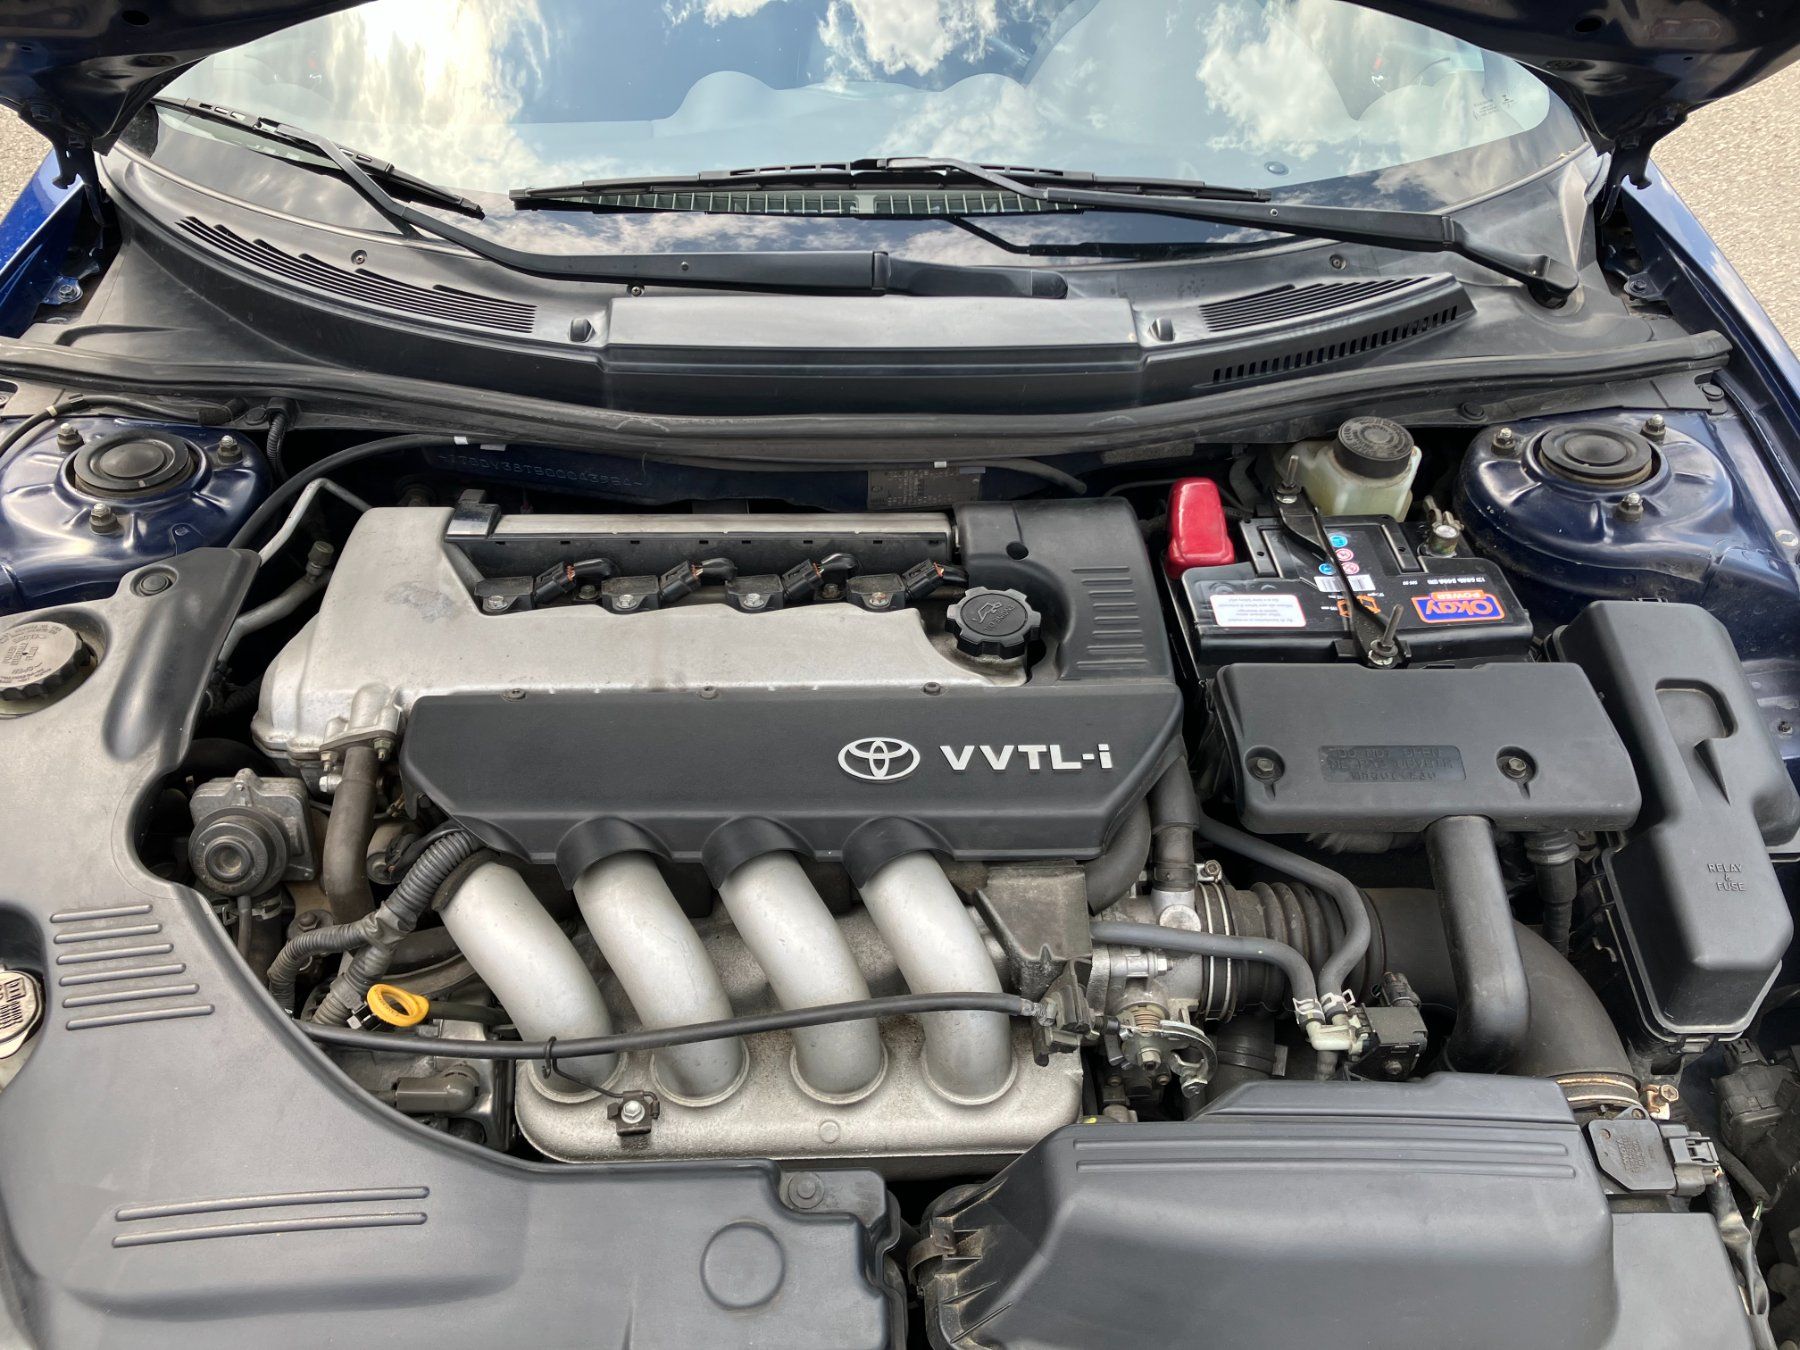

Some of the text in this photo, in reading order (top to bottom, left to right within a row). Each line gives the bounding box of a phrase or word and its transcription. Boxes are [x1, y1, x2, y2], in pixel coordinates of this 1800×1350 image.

[1437, 592, 1481, 600] POWER
[1426, 600, 1493, 615] Okay
[939, 743, 1112, 770] VVTL-i
[1707, 863, 1742, 873] RELAY
[1716, 882, 1746, 892] FUSE
